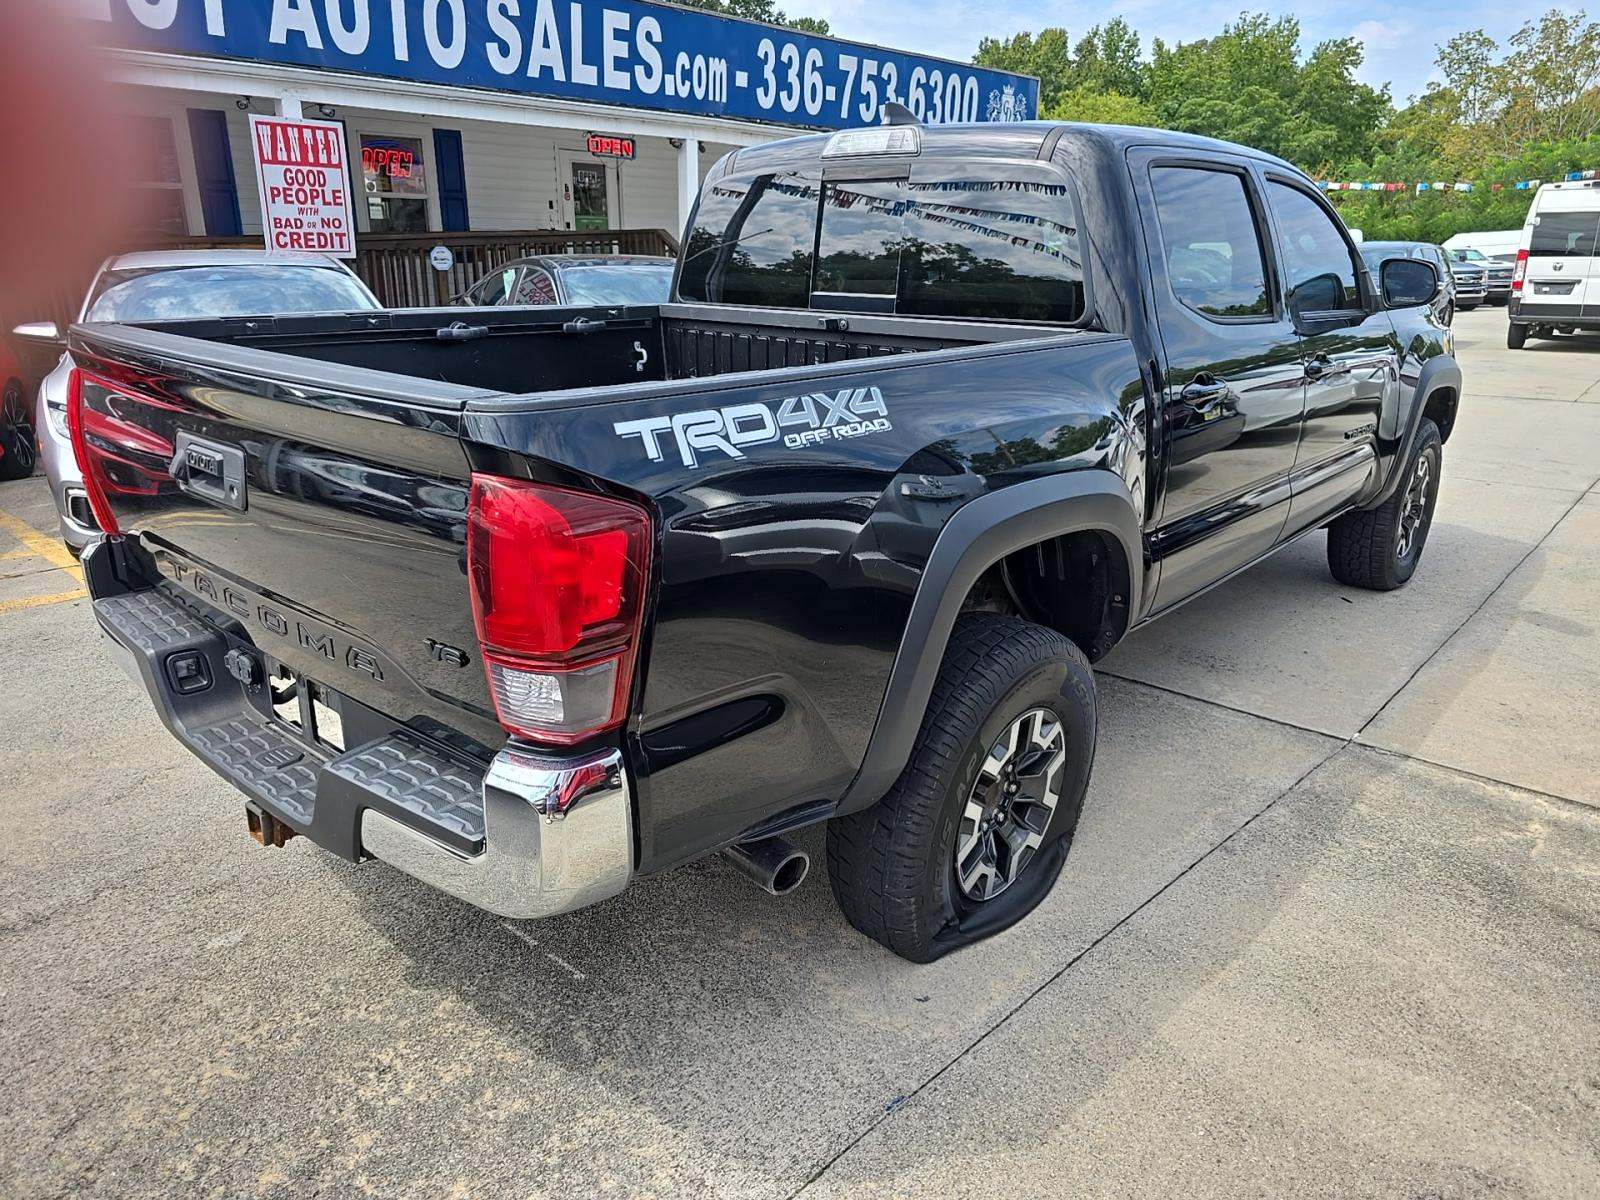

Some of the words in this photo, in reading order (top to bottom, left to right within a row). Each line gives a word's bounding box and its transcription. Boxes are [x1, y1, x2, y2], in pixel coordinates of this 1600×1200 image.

[257, 124, 340, 165] WANTED
[586, 136, 634, 157] OPEN
[361, 148, 412, 177] OPEN
[283, 167, 327, 188] GOOD
[269, 186, 344, 206] PEOPLE
[273, 217, 304, 229] BAD
[306, 221, 317, 229] OR
[320, 217, 342, 229] NO
[297, 206, 319, 217] WITH
[275, 231, 347, 249] CREDIT
[613, 402, 781, 469] TRD
[776, 386, 890, 429] 4X4
[783, 425, 832, 450] OFF
[832, 417, 893, 441] ROAD
[185, 449, 218, 476] TOYOTA
[164, 557, 385, 683] TACOMA
[423, 637, 466, 668] V6
